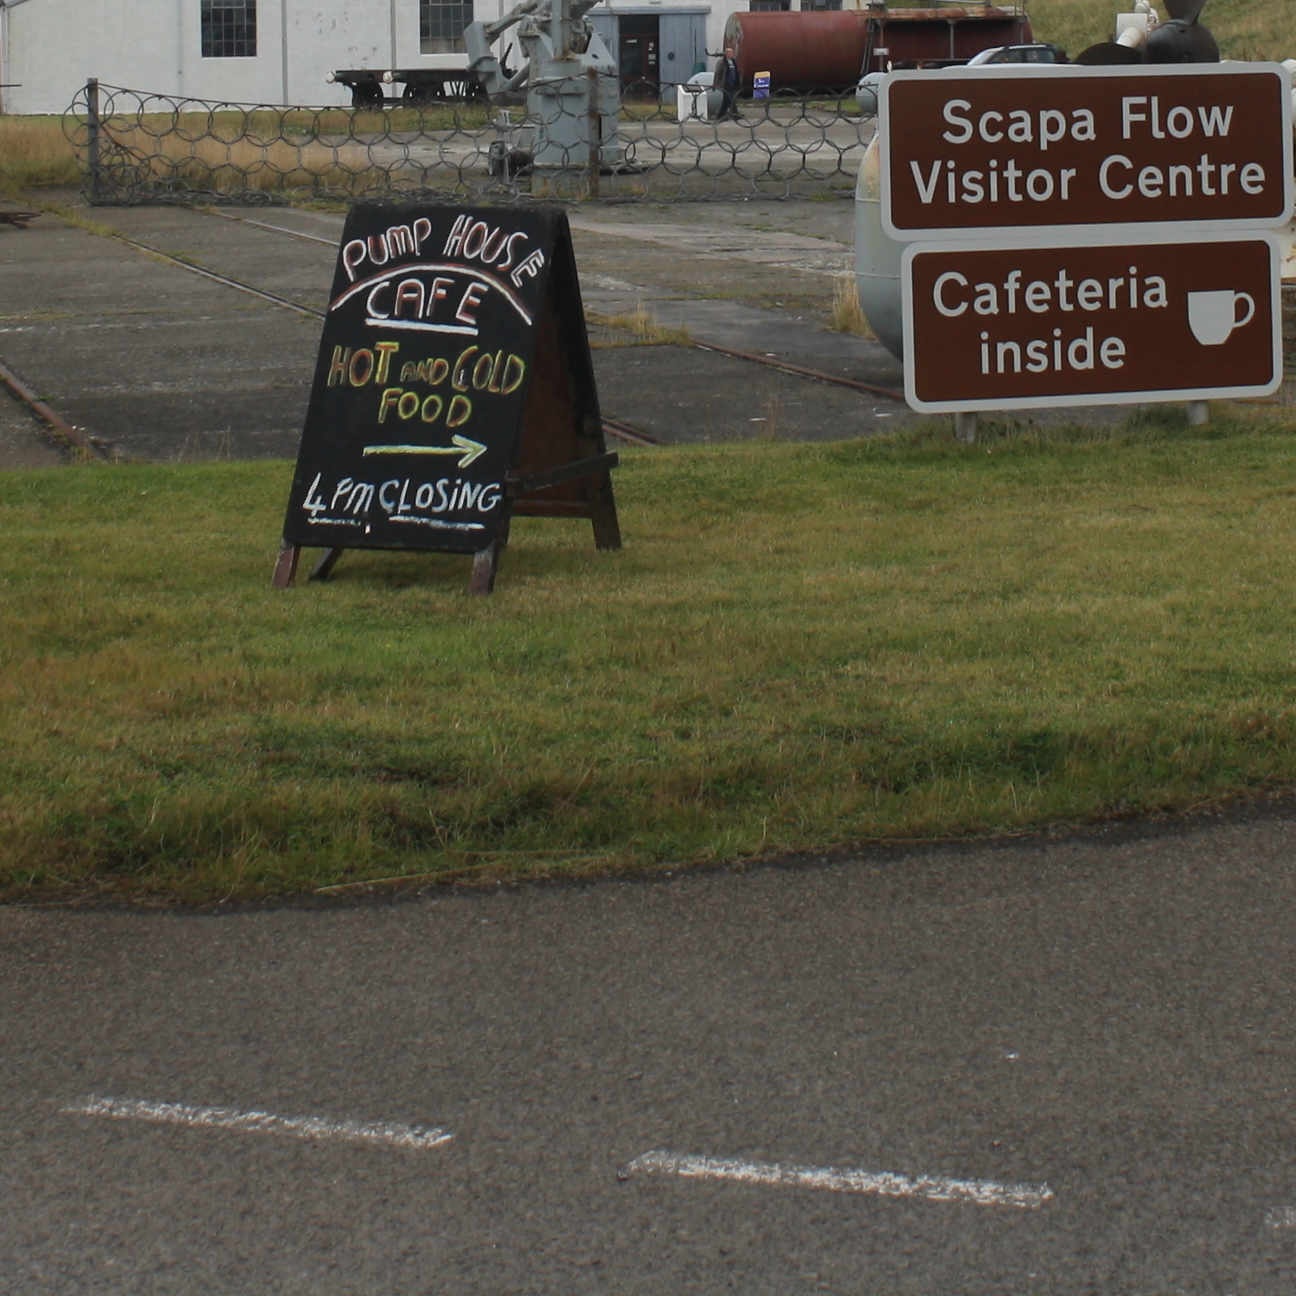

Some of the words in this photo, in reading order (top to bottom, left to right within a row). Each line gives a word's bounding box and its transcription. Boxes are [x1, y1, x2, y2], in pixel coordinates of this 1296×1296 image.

[942, 98, 1096, 151] Scapa
[1121, 95, 1234, 140] Flow
[910, 158, 1077, 204] Visitor
[1099, 153, 1265, 200] Centre
[342, 217, 432, 282] PUMP
[443, 214, 545, 289] HOUSE
[365, 277, 489, 325] CAFE
[933, 265, 1168, 318] Cafeteria
[327, 341, 400, 388] HOT
[400, 357, 450, 386] AND
[451, 344, 526, 396] COLD
[980, 326, 1126, 375] inside
[378, 387, 473, 428] FOOD
